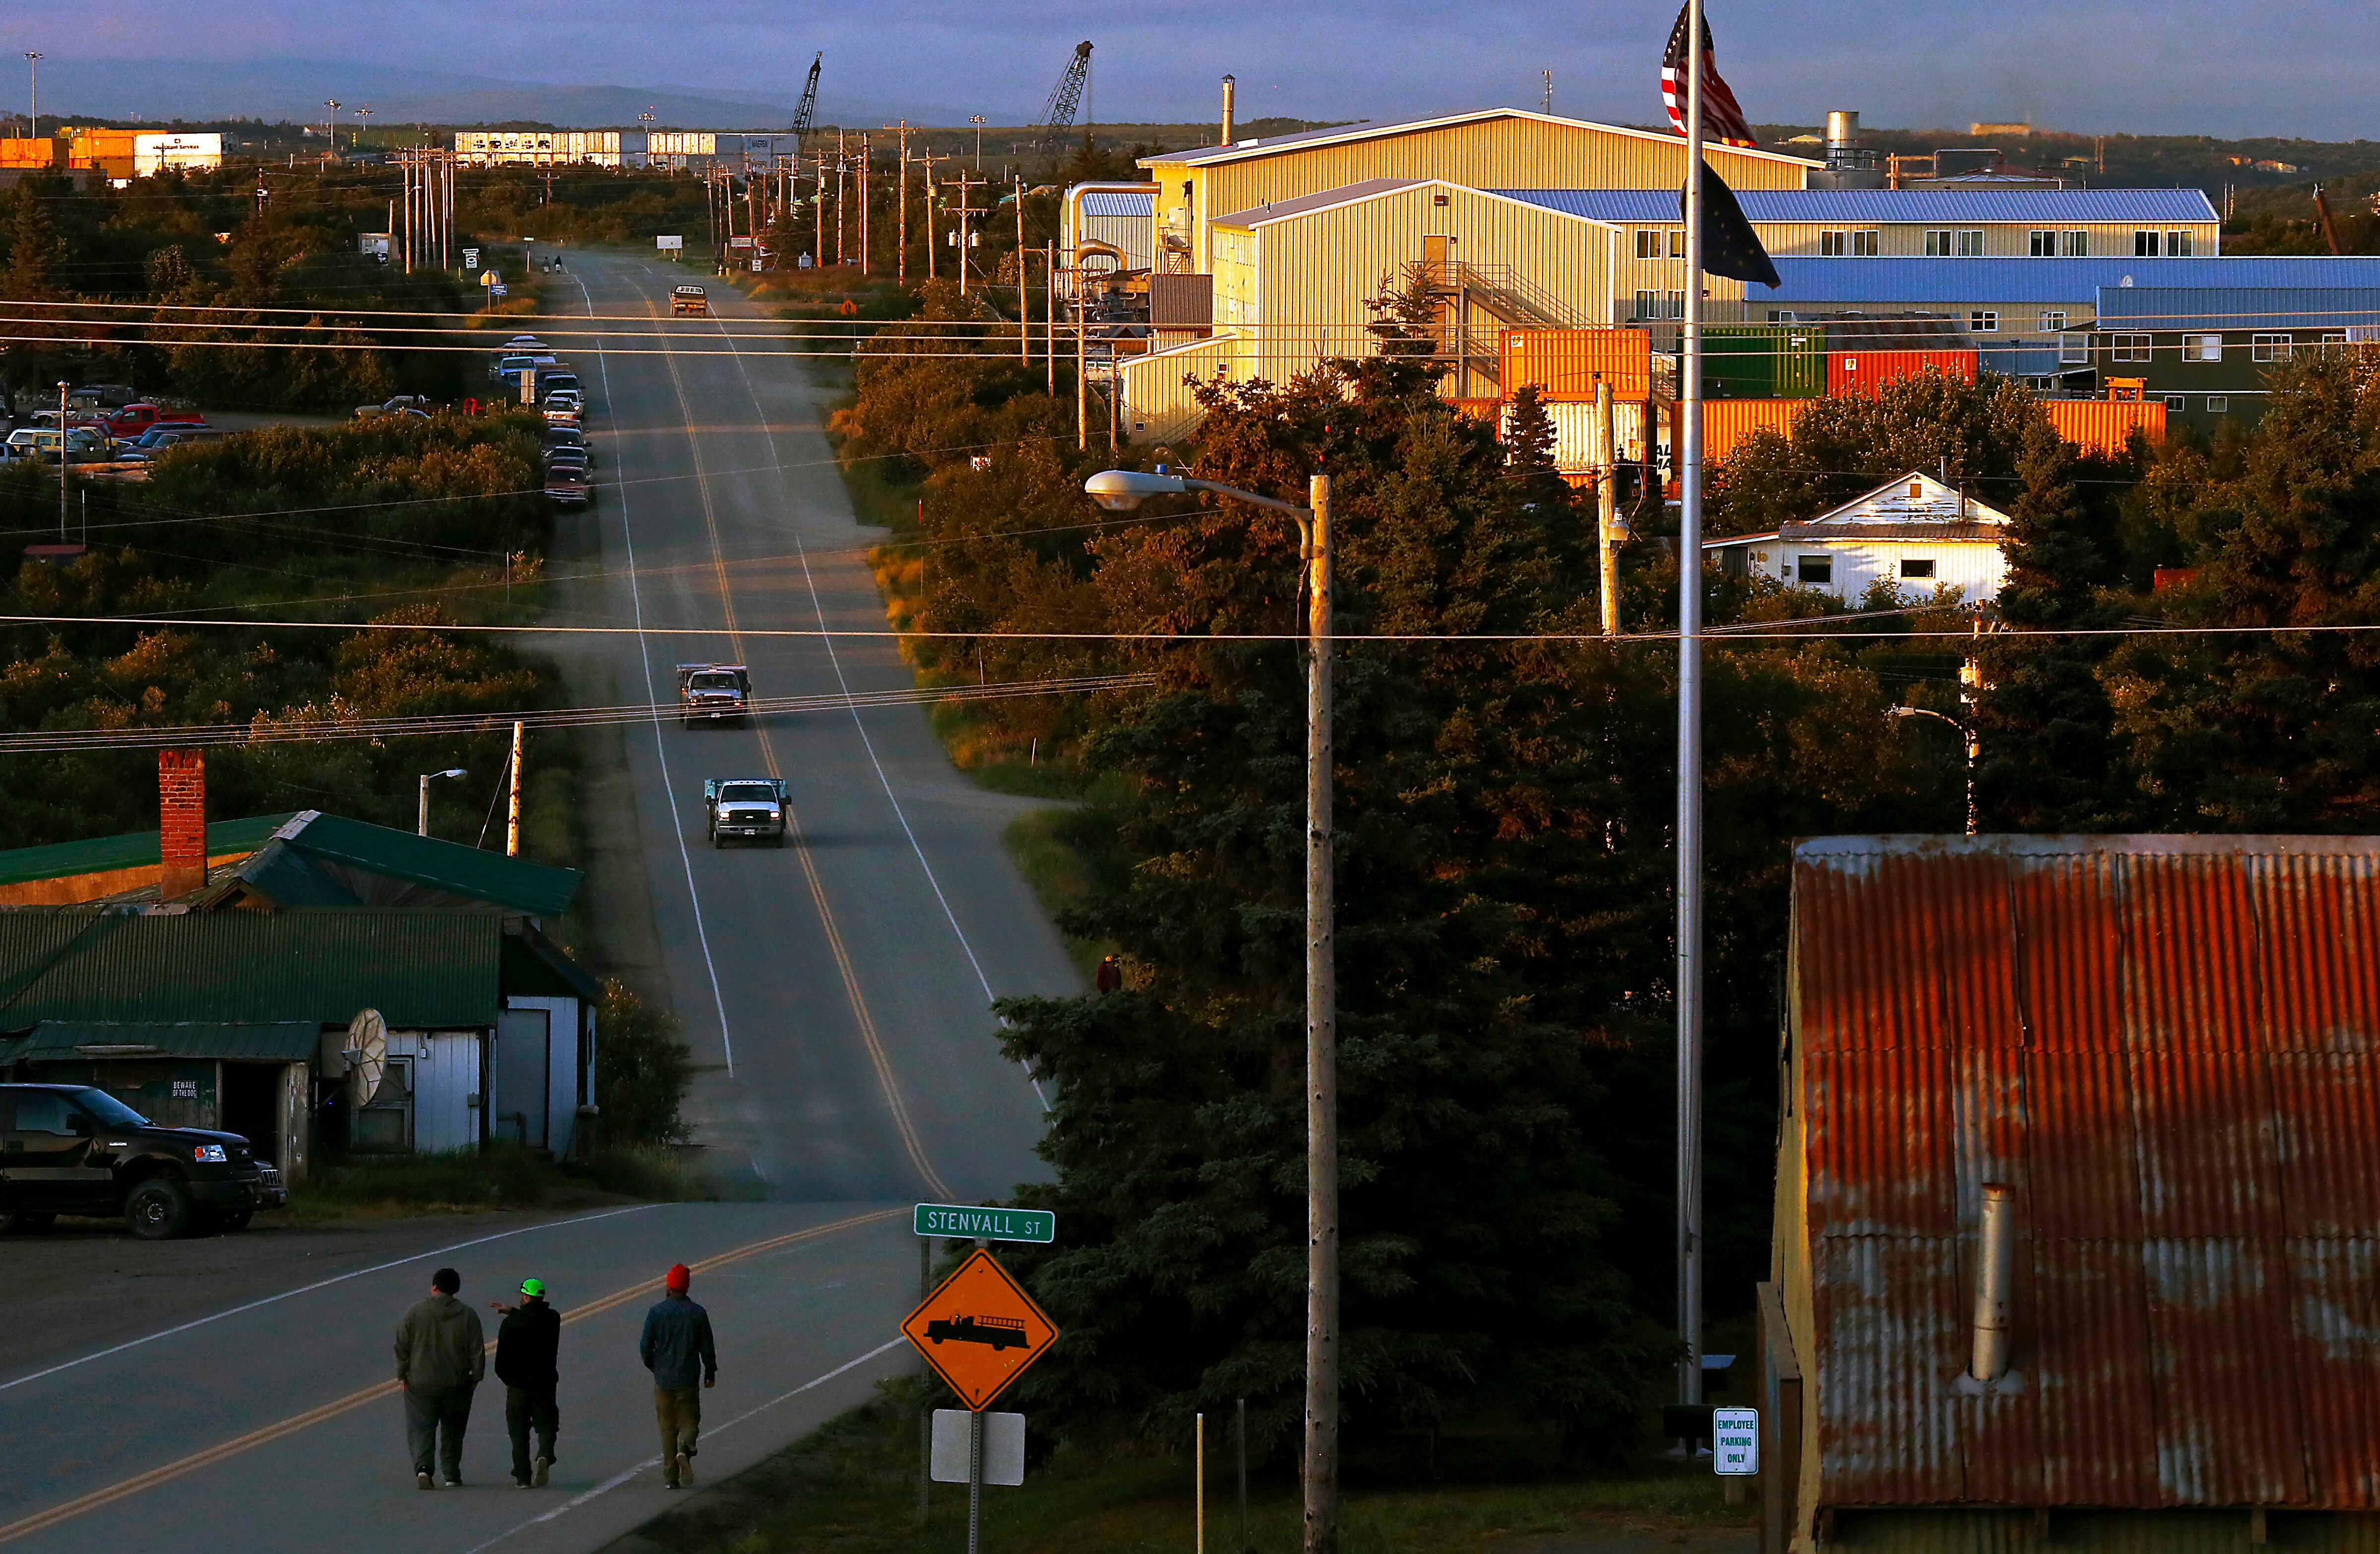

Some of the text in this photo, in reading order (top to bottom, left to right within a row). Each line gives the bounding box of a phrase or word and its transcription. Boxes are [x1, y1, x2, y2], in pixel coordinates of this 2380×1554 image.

[928, 1211, 1040, 1235] STENVALL ST
[1718, 1420, 1754, 1429] EMPLOYEE
[1721, 1437, 1751, 1446] PARKING
[1727, 1453, 1745, 1463] ONLY
